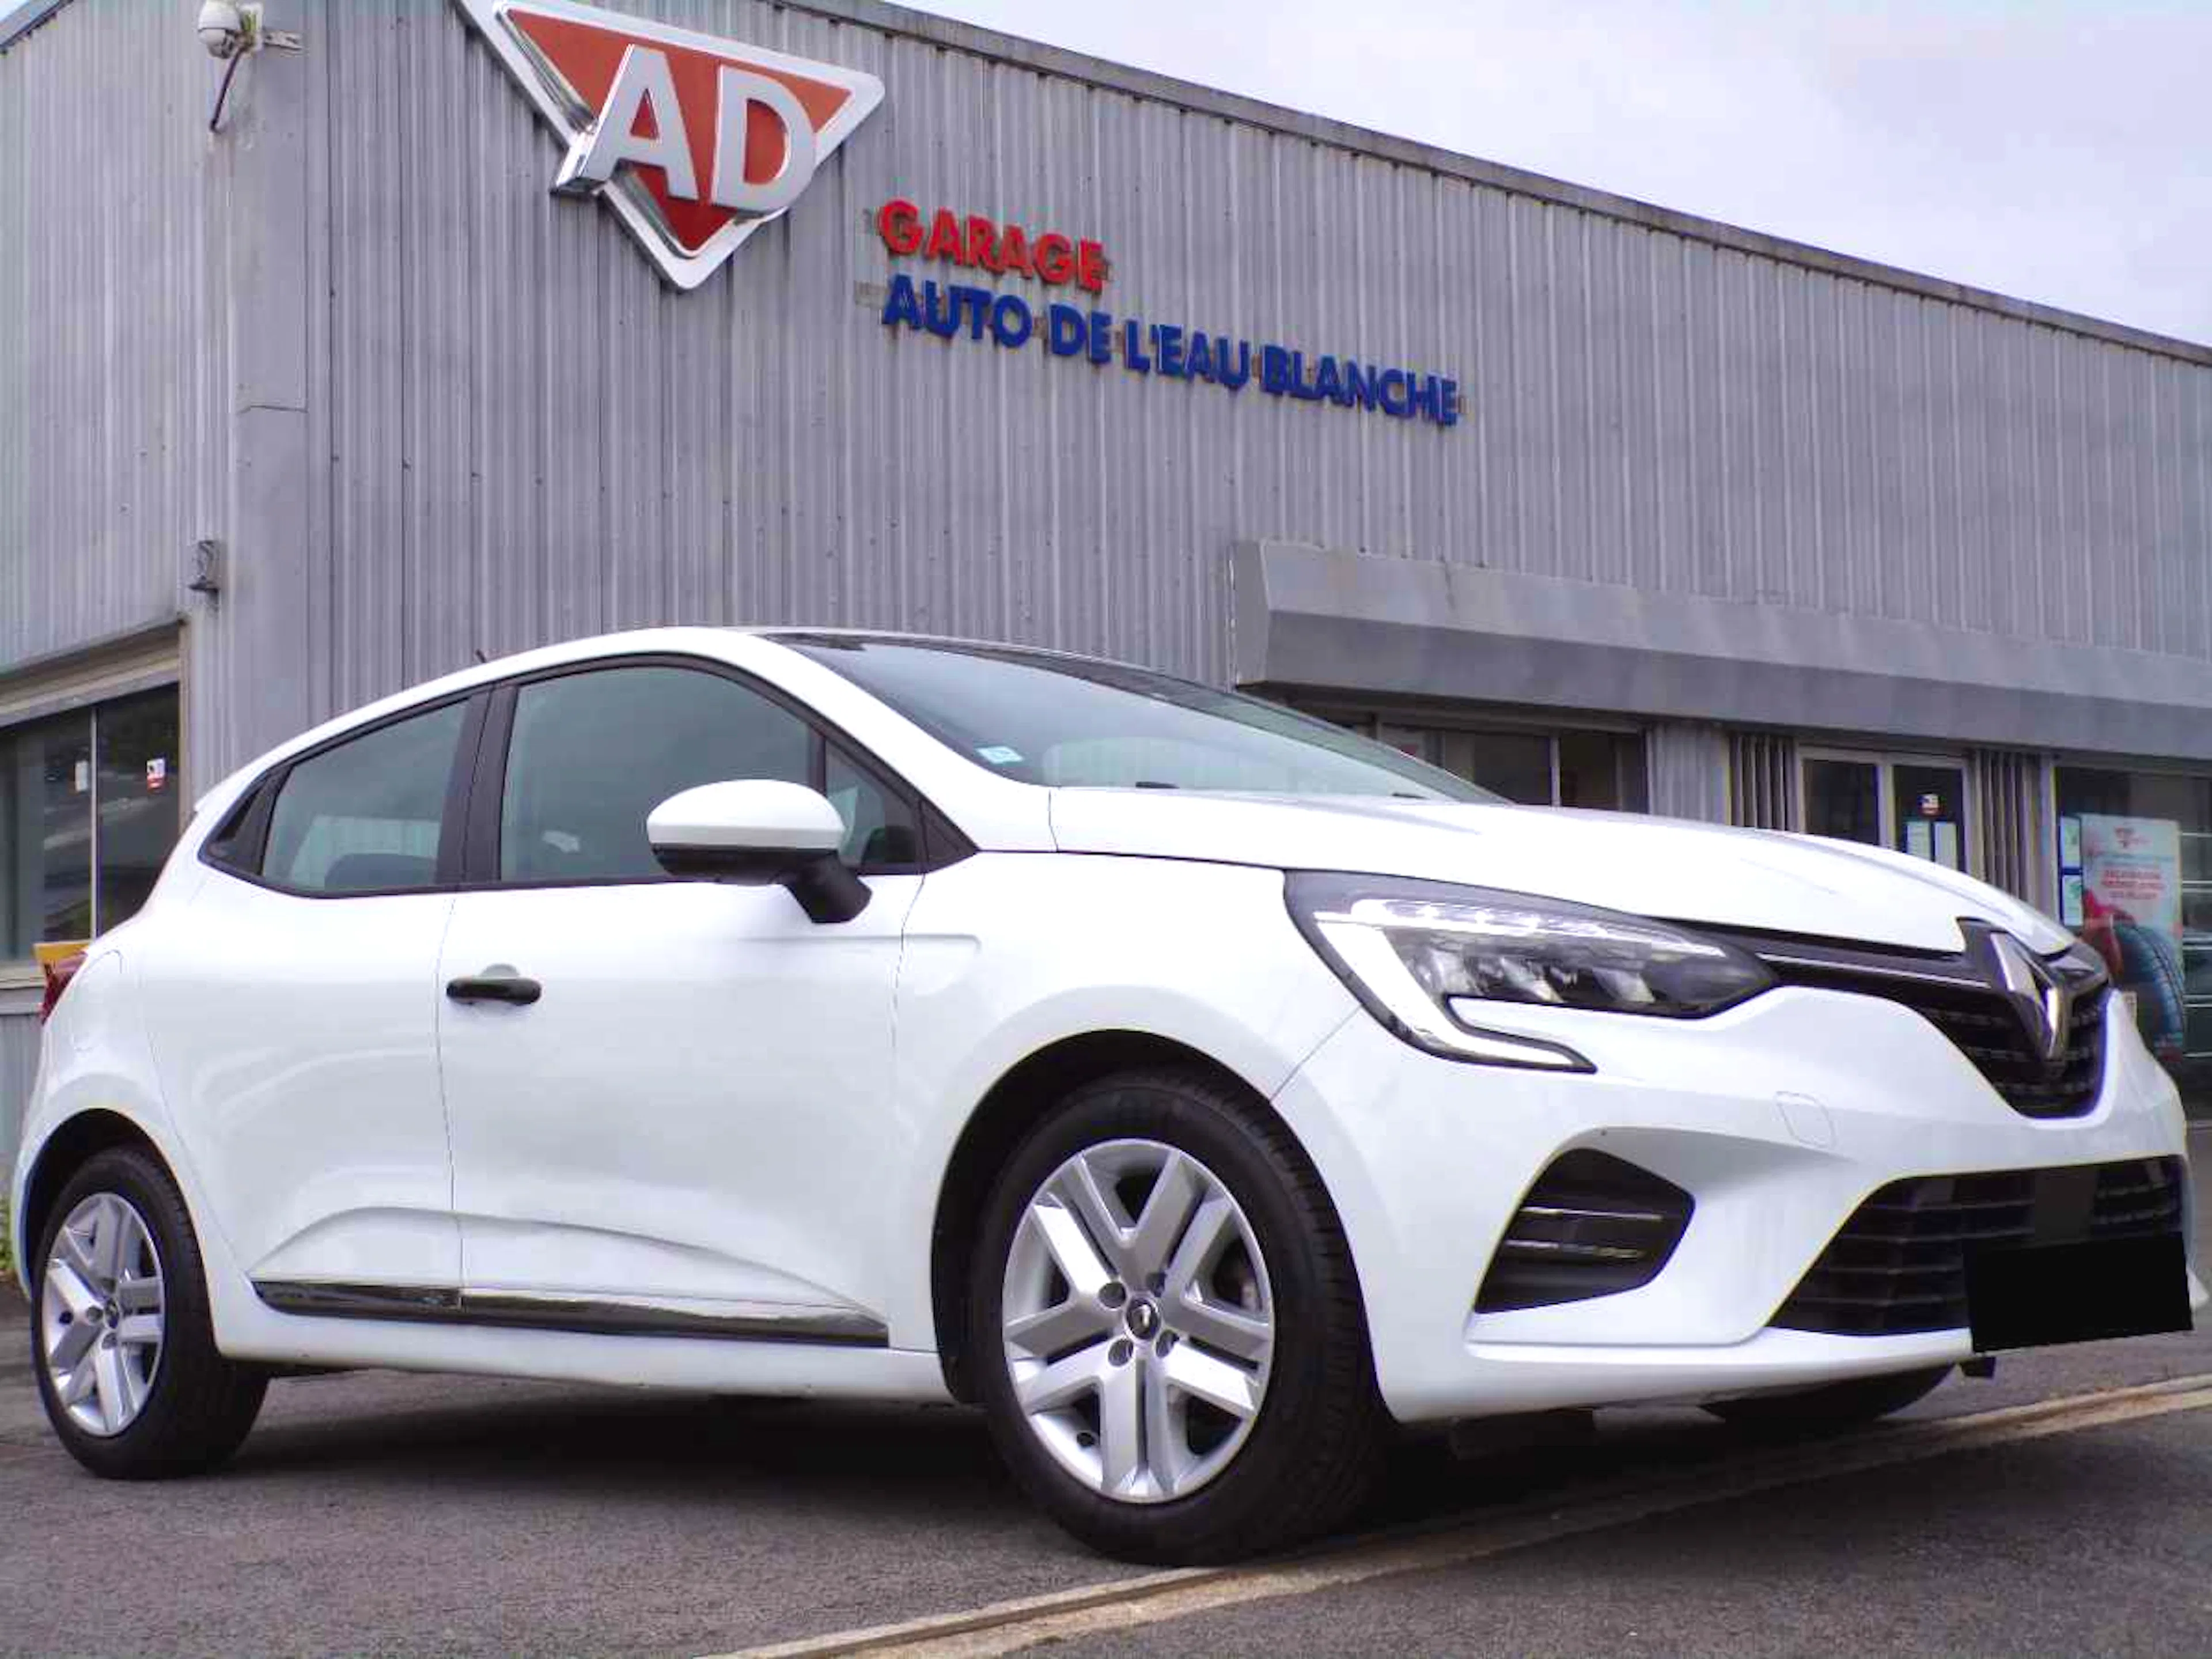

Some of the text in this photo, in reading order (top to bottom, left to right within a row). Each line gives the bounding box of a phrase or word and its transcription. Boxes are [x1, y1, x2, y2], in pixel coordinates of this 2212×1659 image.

[558, 43, 816, 212] AD
[879, 198, 1104, 292] GARAGE
[881, 273, 1457, 426] AUTO DE L'EAU BLANCHE
